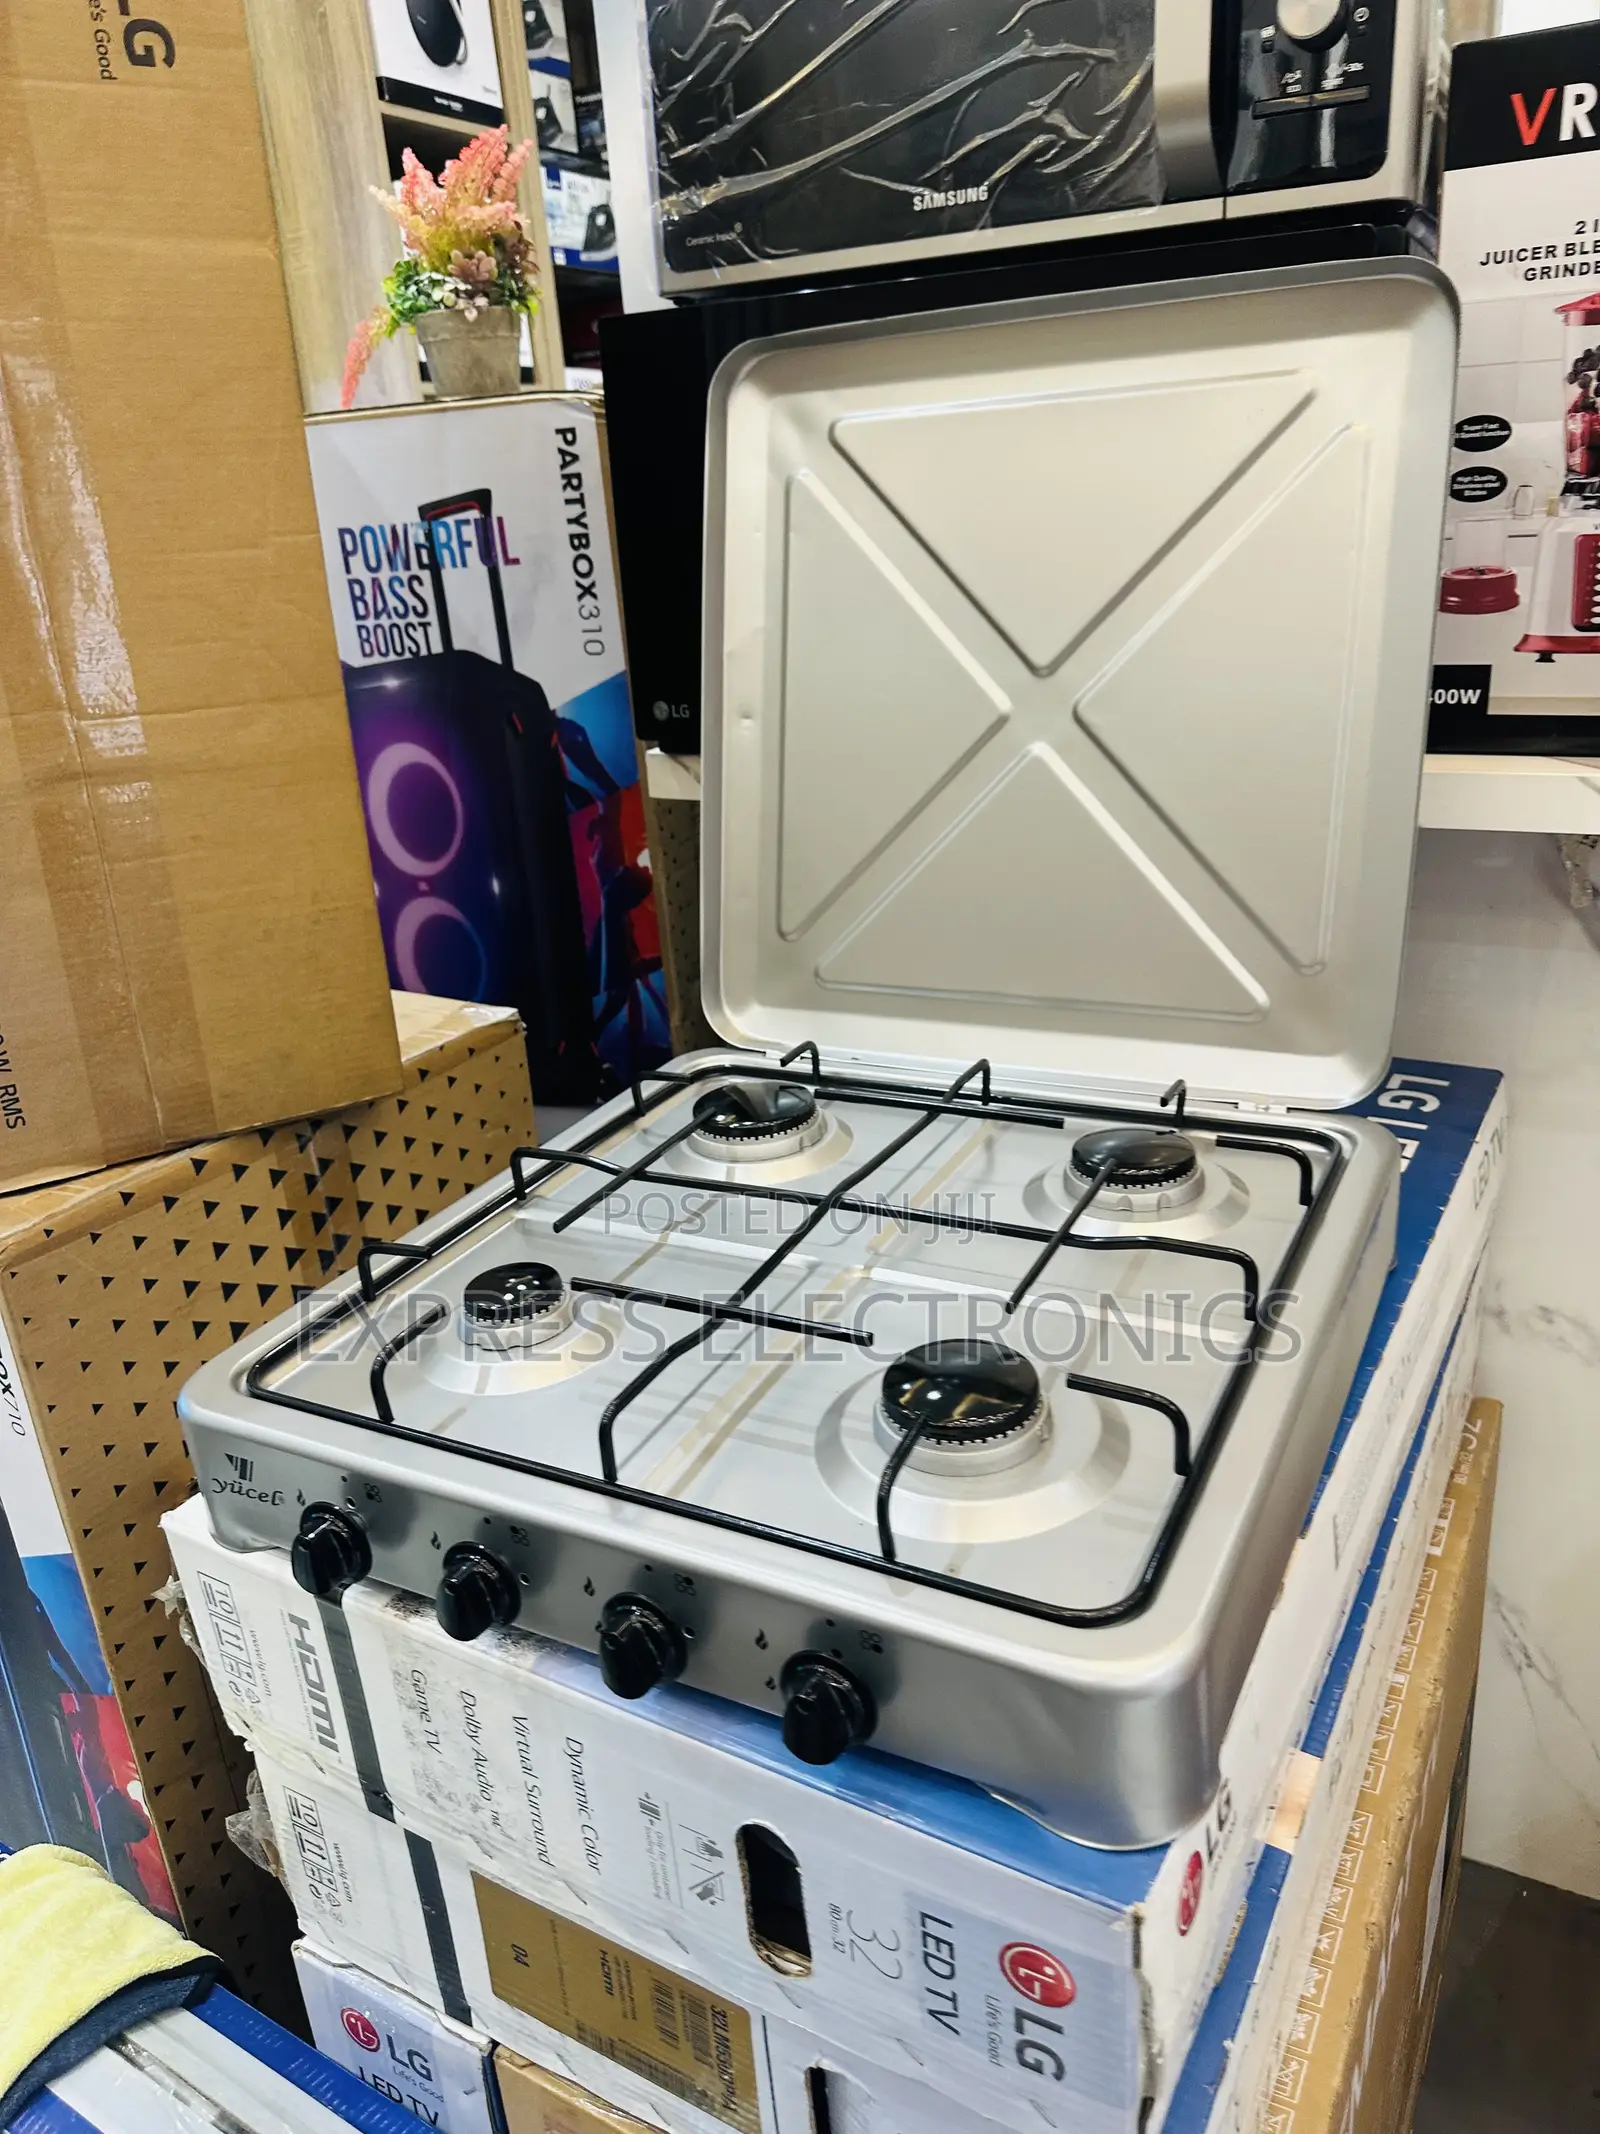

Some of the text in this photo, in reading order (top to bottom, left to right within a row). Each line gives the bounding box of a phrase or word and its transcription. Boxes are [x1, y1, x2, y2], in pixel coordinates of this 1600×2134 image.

[94, 29, 118, 80] Good
[118, 0, 175, 68] G
[1509, 82, 1598, 146] VR
[913, 184, 988, 211] SAMSUNG
[1479, 240, 1600, 266] JUICER BLE
[1574, 220, 1587, 235] 2
[1523, 260, 1600, 282] GRINDE
[337, 516, 521, 575] POWERFUL
[554, 426, 606, 657] PARTYBOX310
[347, 574, 429, 621] BASS
[357, 621, 432, 658] BOOST
[671, 704, 690, 718] LG
[1428, 689, 1481, 704] 00W
[0, 1083, 26, 1130] RMS
[1376, 1073, 1451, 1112] LG
[0, 1346, 26, 1436] OX710
[214, 1588, 234, 1615] 10
[250, 1629, 272, 1697] www.lg.com
[288, 1612, 340, 1753] HDMI
[410, 1669, 442, 1755] Game TV
[460, 1689, 482, 1746] Dolby
[472, 1748, 494, 1802] Audio
[300, 1803, 318, 1828] 10
[512, 1715, 556, 1868] Virtual Surround
[563, 1736, 603, 1876] Dynamic Color
[510, 1943, 530, 1968] 04
[846, 1909, 903, 1980] 32
[598, 1948, 615, 1997] HDMI
[919, 1911, 960, 2036] LED TV
[985, 1994, 1005, 2068] Life's Good
[1013, 2006, 1066, 2082] LG
[386, 2033, 433, 2081] LG
[359, 2066, 438, 2126] LED TV
[392, 2065, 445, 2103] Life's Good
